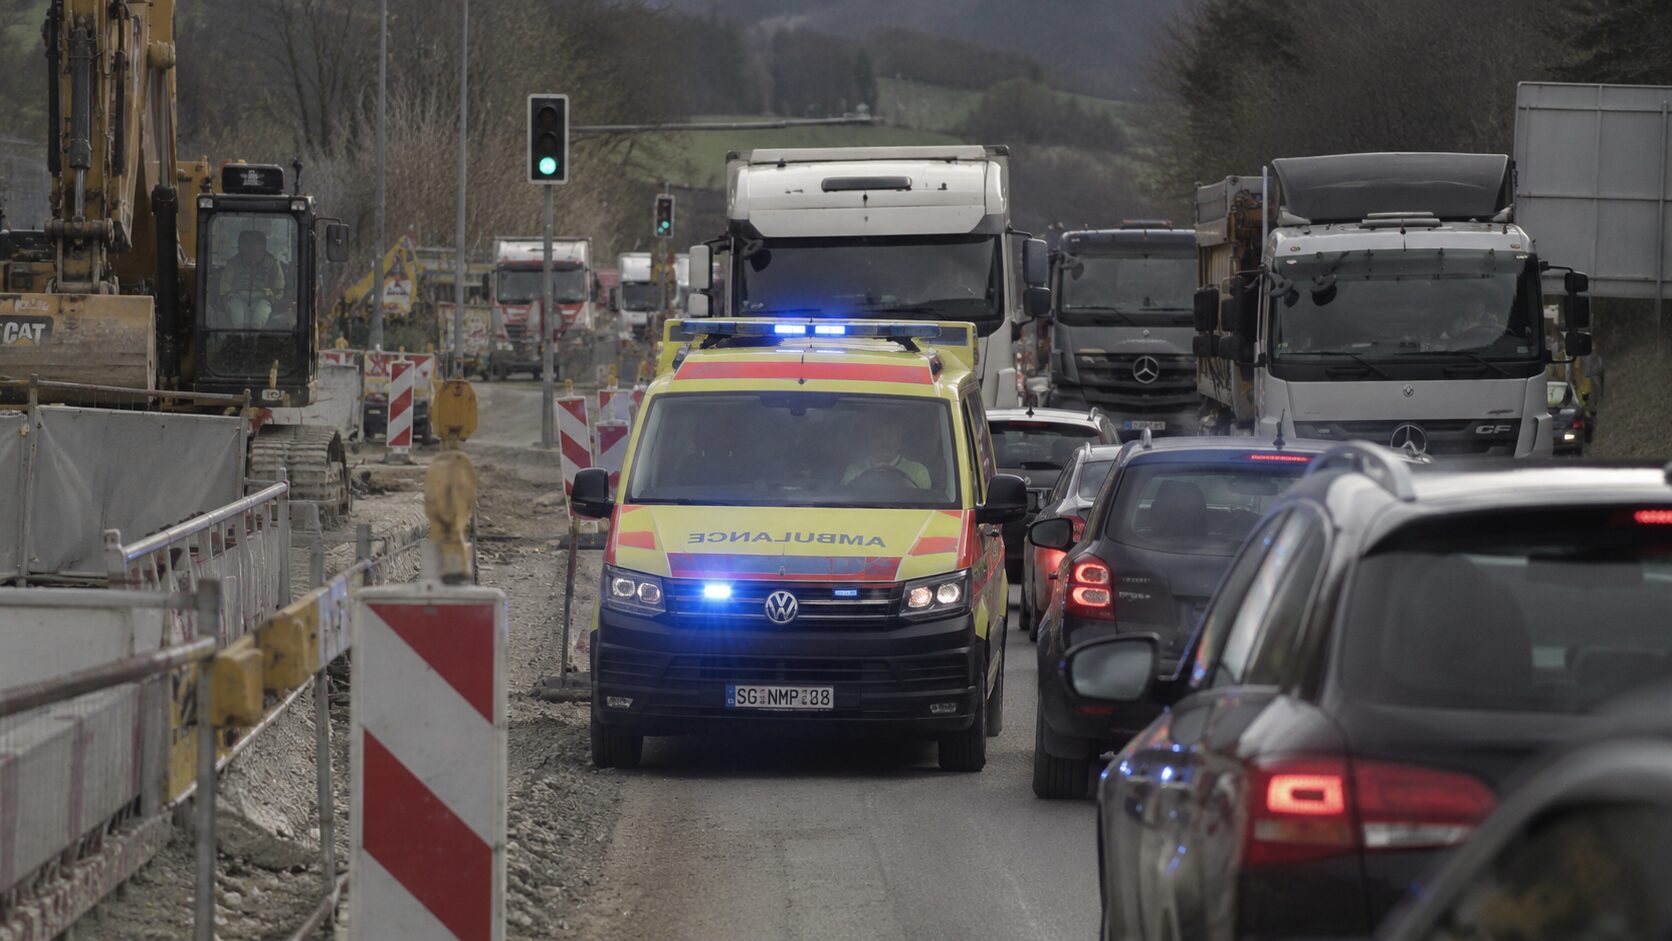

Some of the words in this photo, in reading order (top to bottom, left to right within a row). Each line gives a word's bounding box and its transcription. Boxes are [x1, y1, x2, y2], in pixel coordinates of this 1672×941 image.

[3, 321, 46, 346] CAT
[737, 688, 757, 705] SG
[768, 689, 798, 705] NMP
